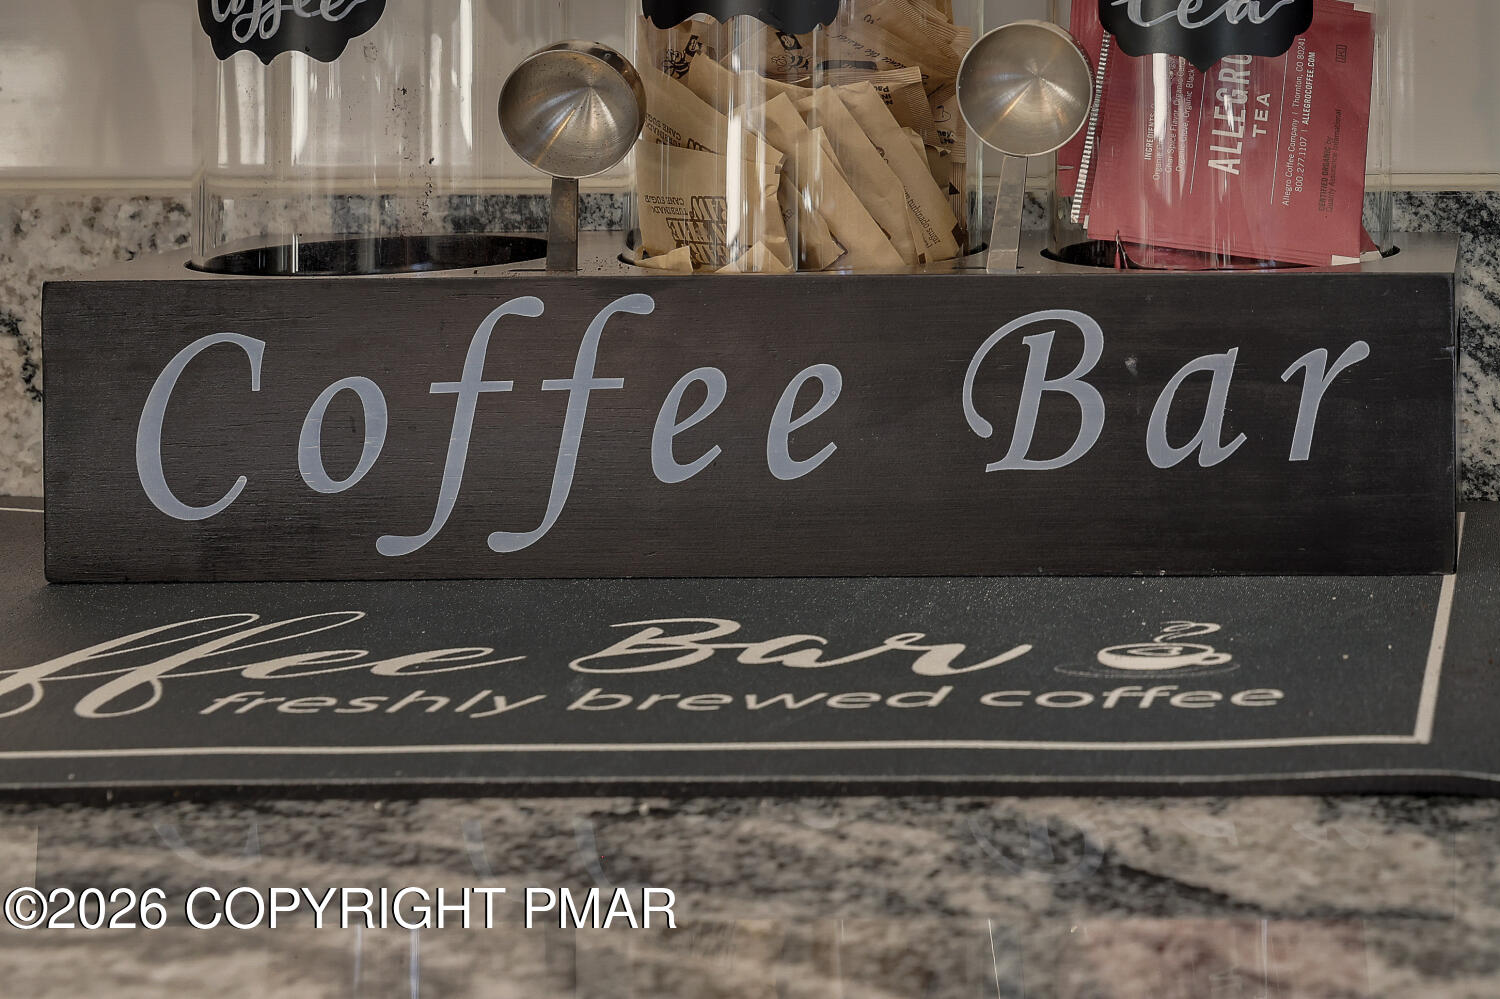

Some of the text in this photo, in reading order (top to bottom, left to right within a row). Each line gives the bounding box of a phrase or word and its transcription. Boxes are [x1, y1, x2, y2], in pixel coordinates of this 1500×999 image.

[1252, 93, 1270, 138] TEA
[1282, 37, 1306, 206] Allegro Coffee Company Thornton, CO 80241
[1301, 51, 1316, 125] ALLEGROCOFFEE.COM
[136, 294, 1370, 556] Coffee Bar
[0, 611, 1033, 718] ffee Bar
[199, 684, 1285, 718] freshly brewed coffee
